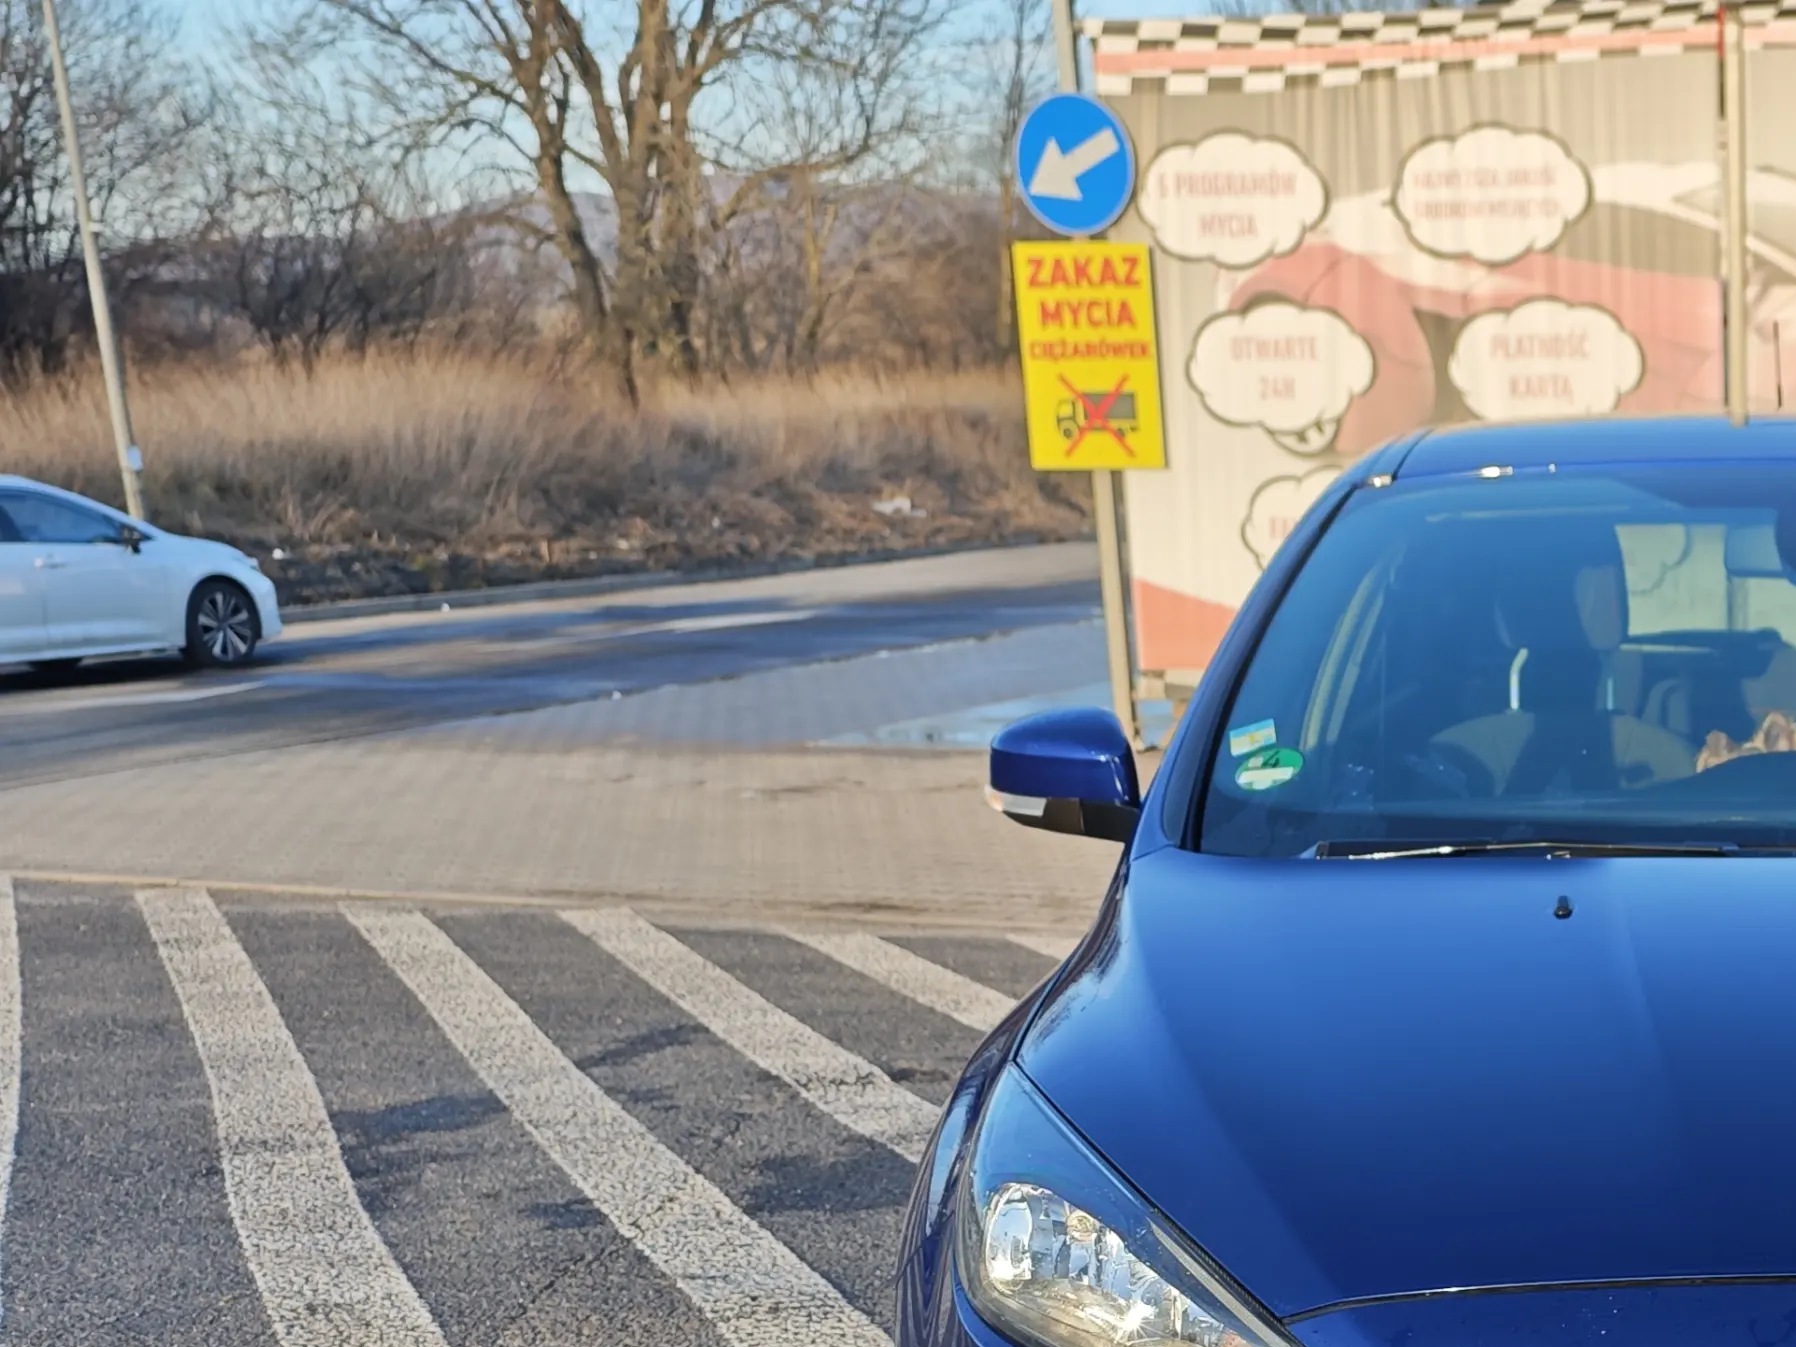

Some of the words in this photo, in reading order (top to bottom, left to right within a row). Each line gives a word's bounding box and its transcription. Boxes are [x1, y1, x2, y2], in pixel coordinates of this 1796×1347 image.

[1199, 212, 1258, 238] MYCIA
[1027, 256, 1141, 288] ZAKAZ
[1039, 299, 1137, 330] MYCIA
[1230, 335, 1319, 361] OTWARTE
